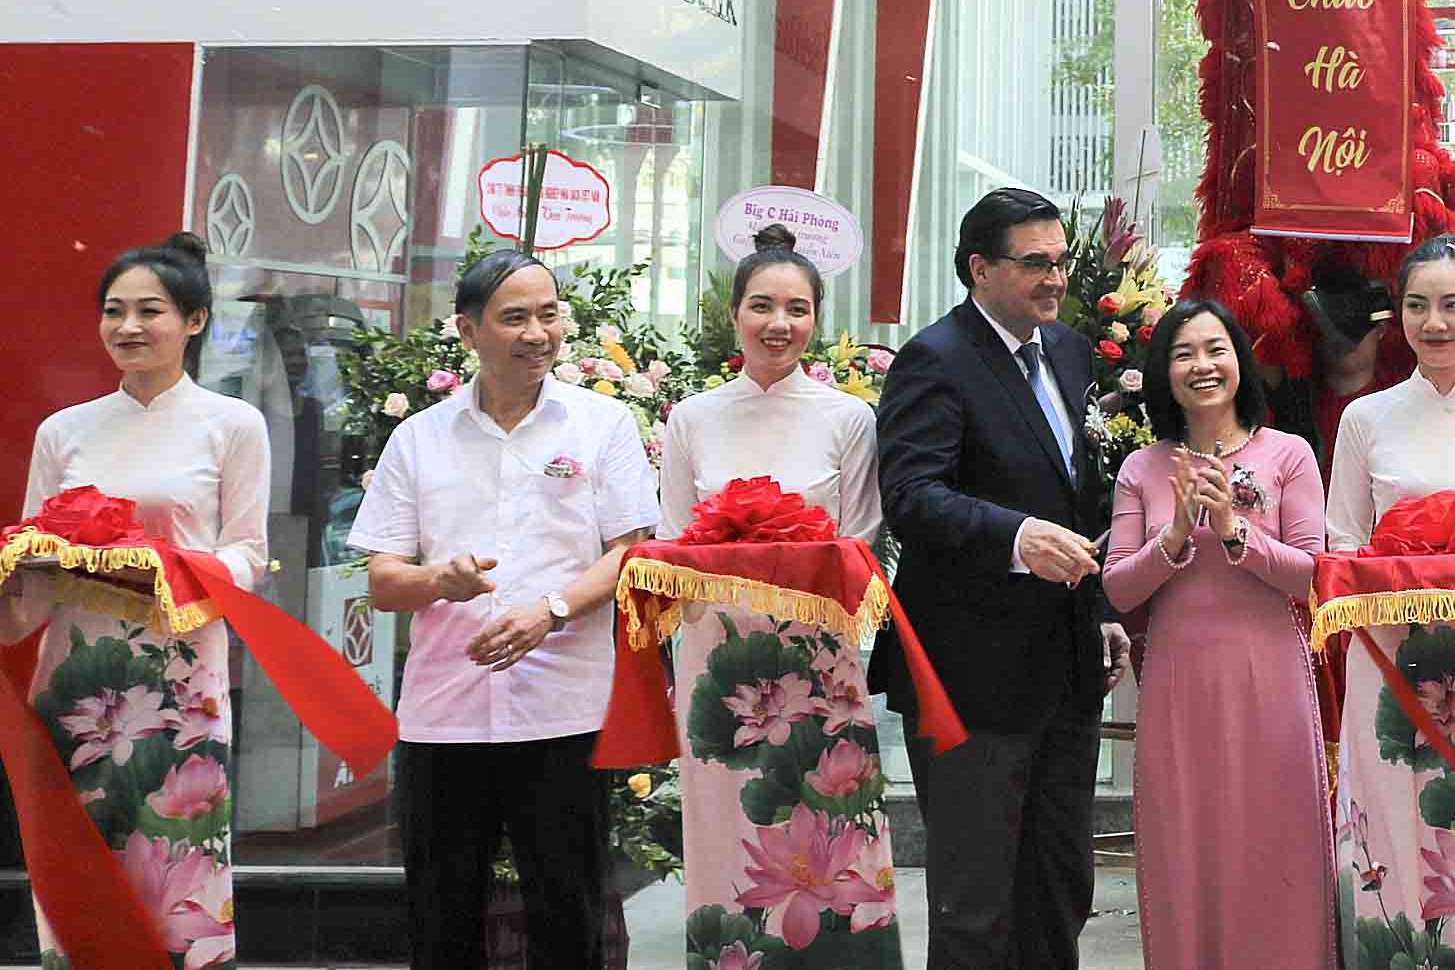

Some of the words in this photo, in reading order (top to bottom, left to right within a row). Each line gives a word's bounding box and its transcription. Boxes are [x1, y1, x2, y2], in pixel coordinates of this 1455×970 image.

[1303, 45, 1366, 94] Hà
[1297, 126, 1372, 176] Nội
[743, 202, 764, 219] Big
[767, 206, 776, 218] C
